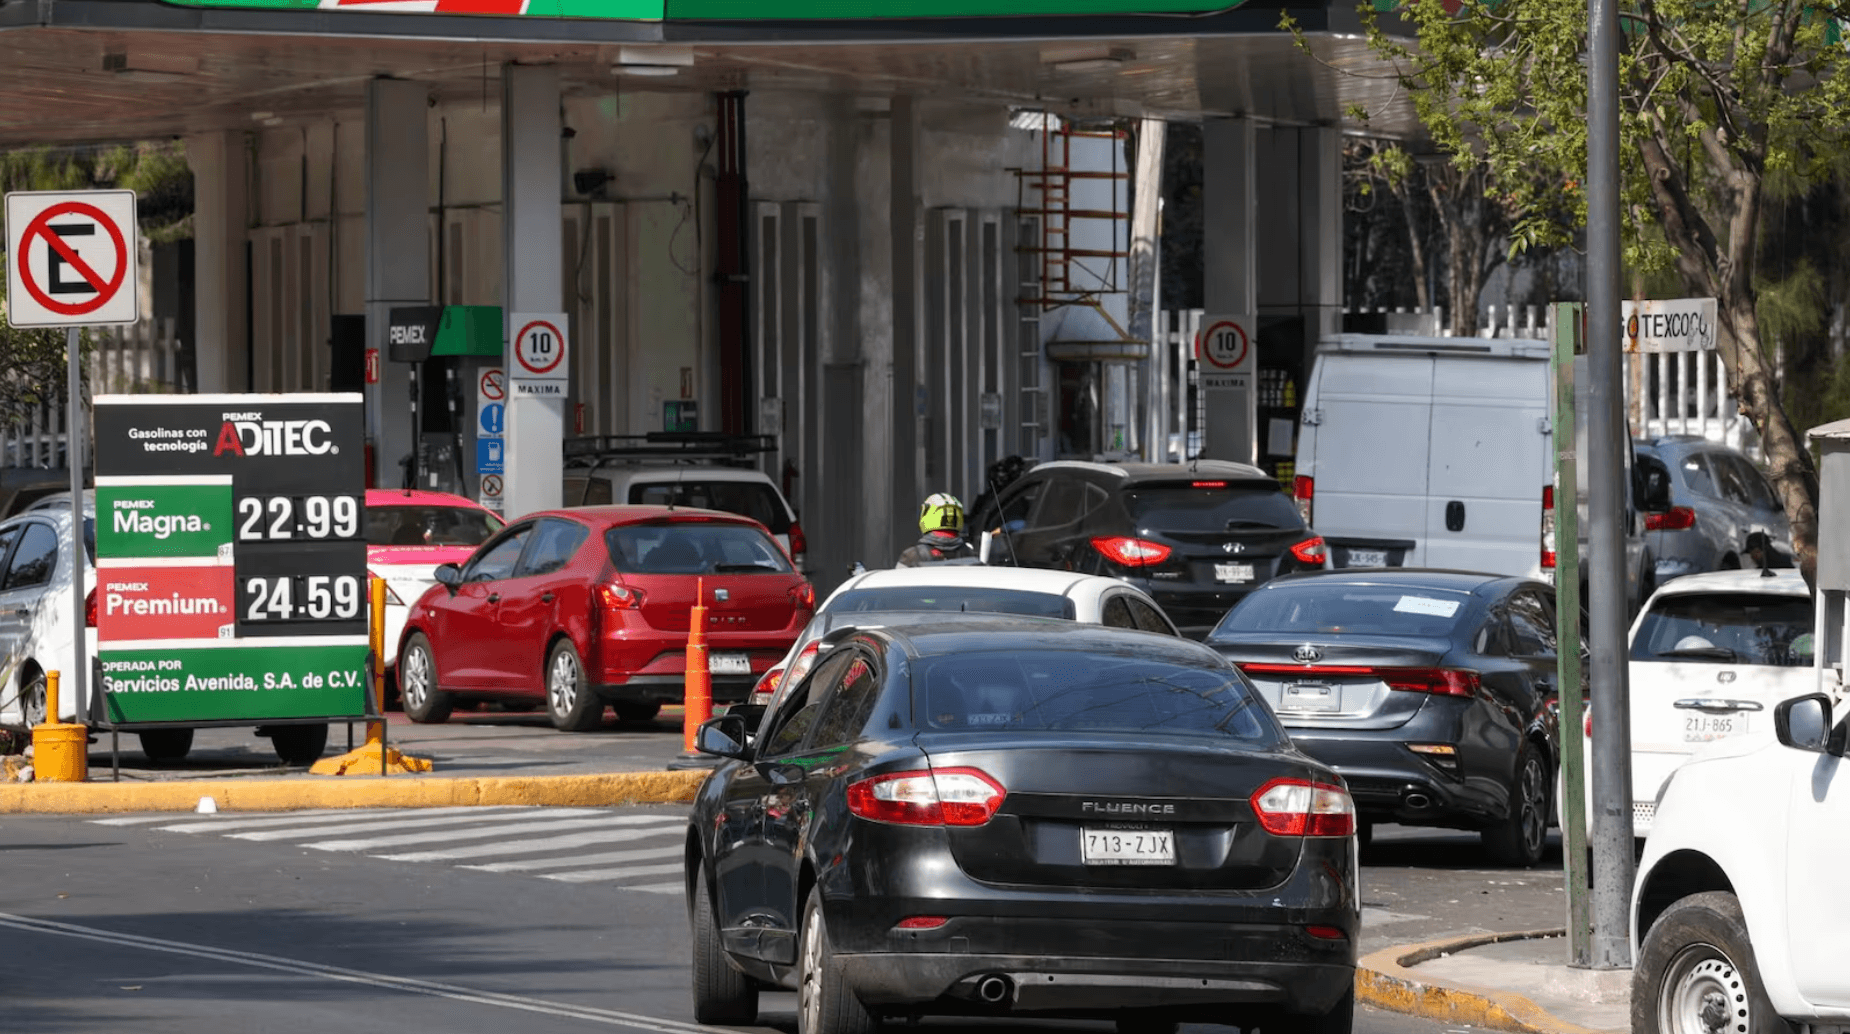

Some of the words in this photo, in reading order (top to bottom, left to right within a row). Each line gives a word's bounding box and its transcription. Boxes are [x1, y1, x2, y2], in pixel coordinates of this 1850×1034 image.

[390, 325, 426, 344] PEMEX
[530, 332, 551, 353] 10
[1217, 332, 1236, 351] 10
[518, 385, 560, 394] MAXIMA
[222, 412, 262, 421] PEMEX
[128, 428, 184, 439] Gasolinas
[186, 428, 207, 438] con
[144, 440, 207, 453] tecnología
[113, 500, 155, 509] PEMEX
[239, 496, 358, 540] 22.99
[106, 583, 149, 591] PEMEX
[247, 575, 359, 620] 24.59
[102, 661, 156, 672] OPERADA
[158, 660, 182, 670] POR
[104, 674, 180, 693] Servicios
[185, 673, 259, 691] Avenida,
[264, 671, 297, 689] S.A.
[302, 671, 323, 688] de
[328, 670, 362, 688] C.V.
[1686, 718, 1732, 732] 21J-865
[1082, 802, 1175, 814] FLUENCE
[1089, 835, 1168, 854] 713-ZJX
